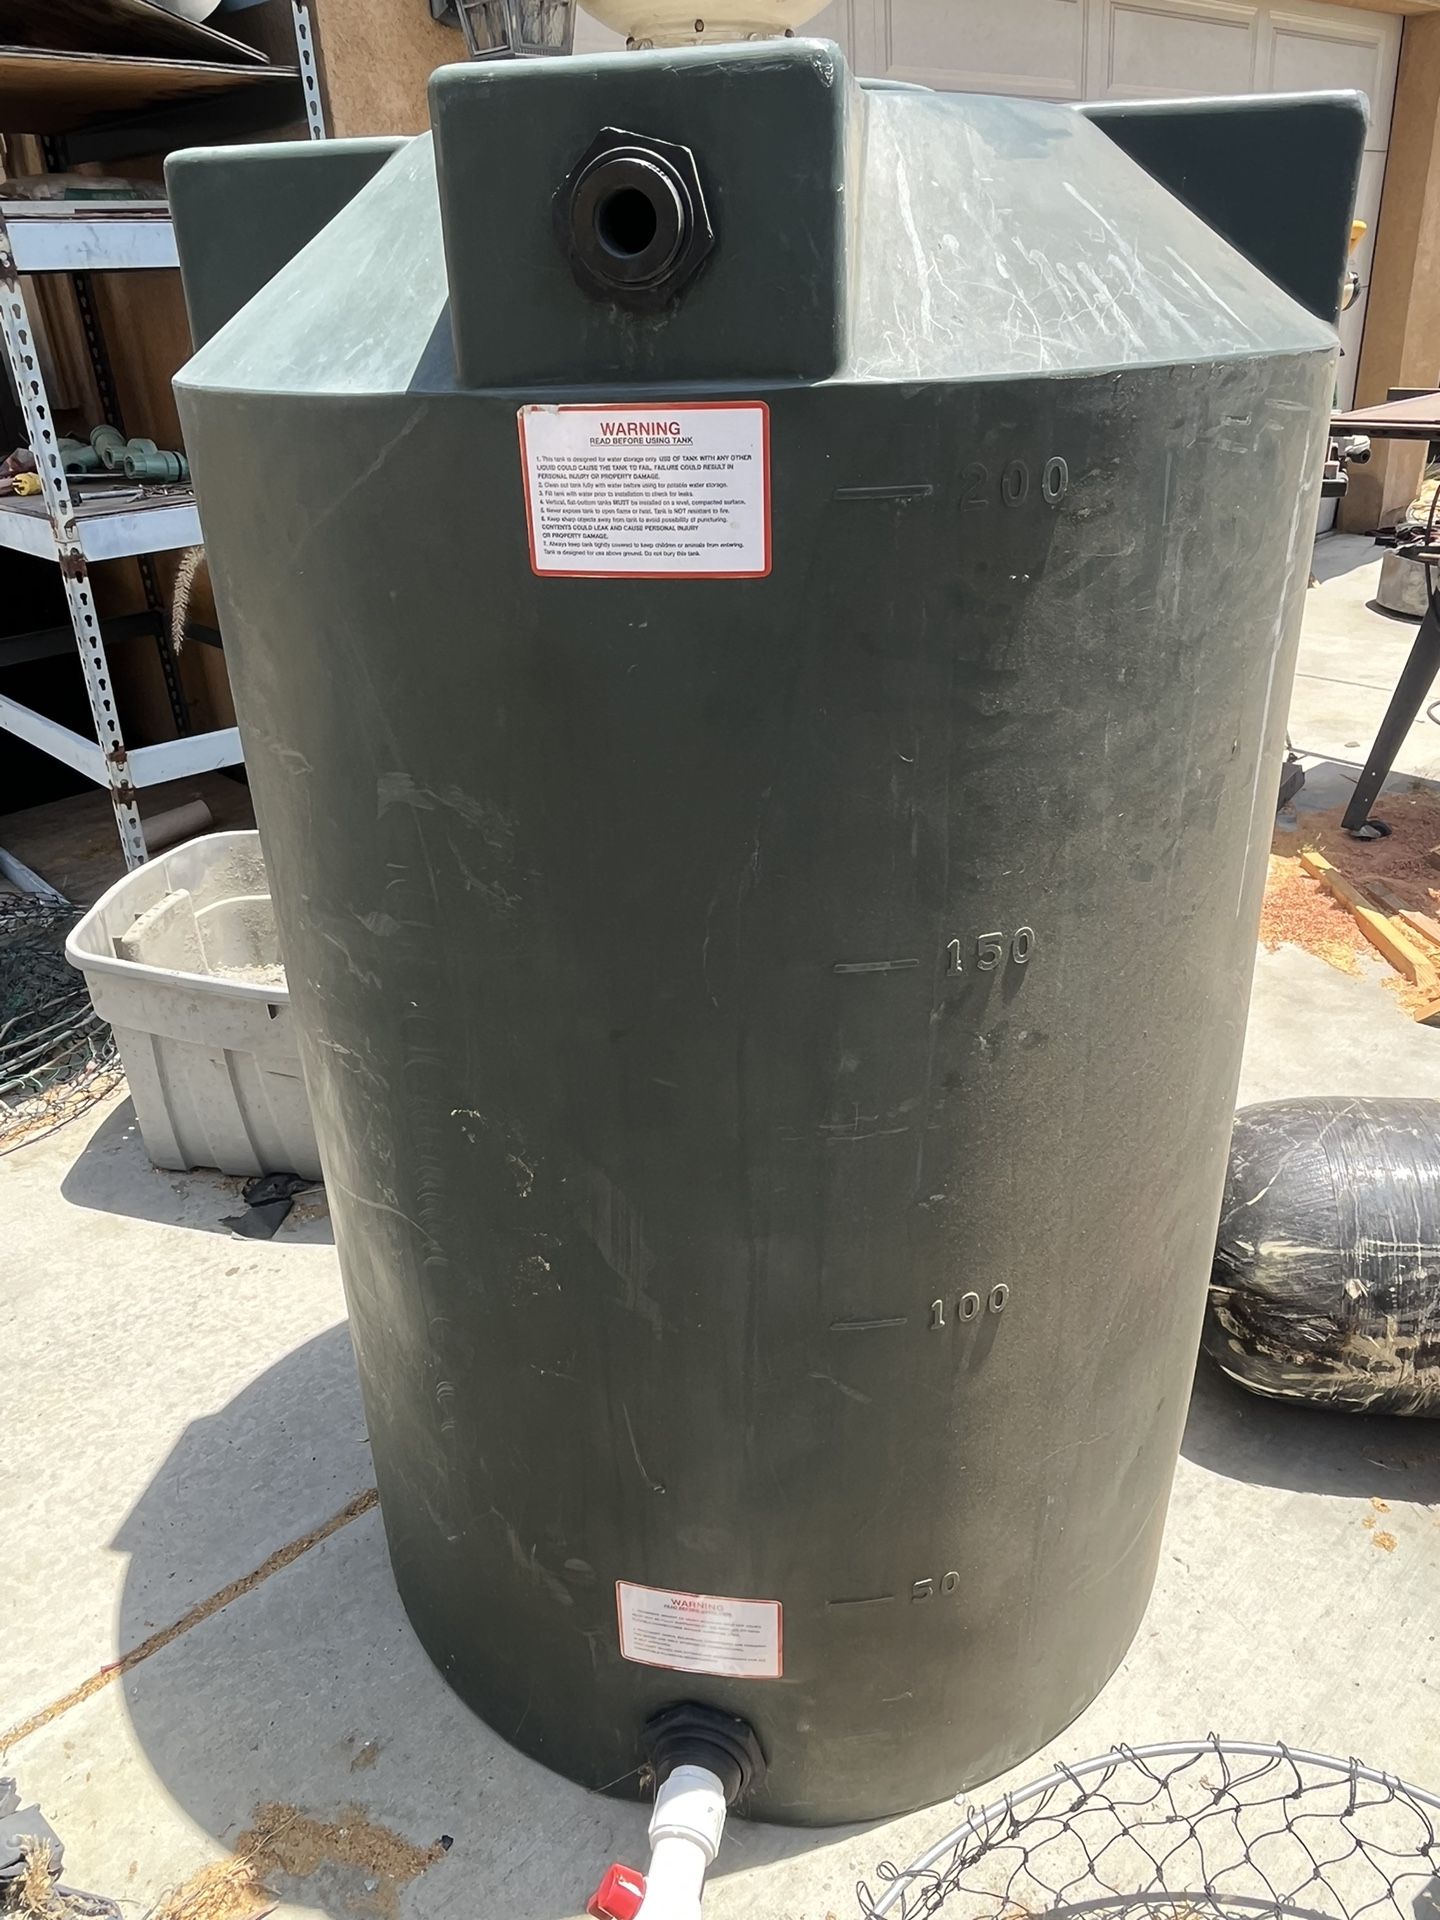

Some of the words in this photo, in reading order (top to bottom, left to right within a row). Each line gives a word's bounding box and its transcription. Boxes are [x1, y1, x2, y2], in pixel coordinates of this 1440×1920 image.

[600, 422, 681, 436] WARNING
[960, 455, 1070, 513] 200
[944, 926, 1036, 977] 150
[929, 1282, 1010, 1331] 100
[671, 1599, 724, 1611] WARNING
[910, 1570, 961, 1604] 50
